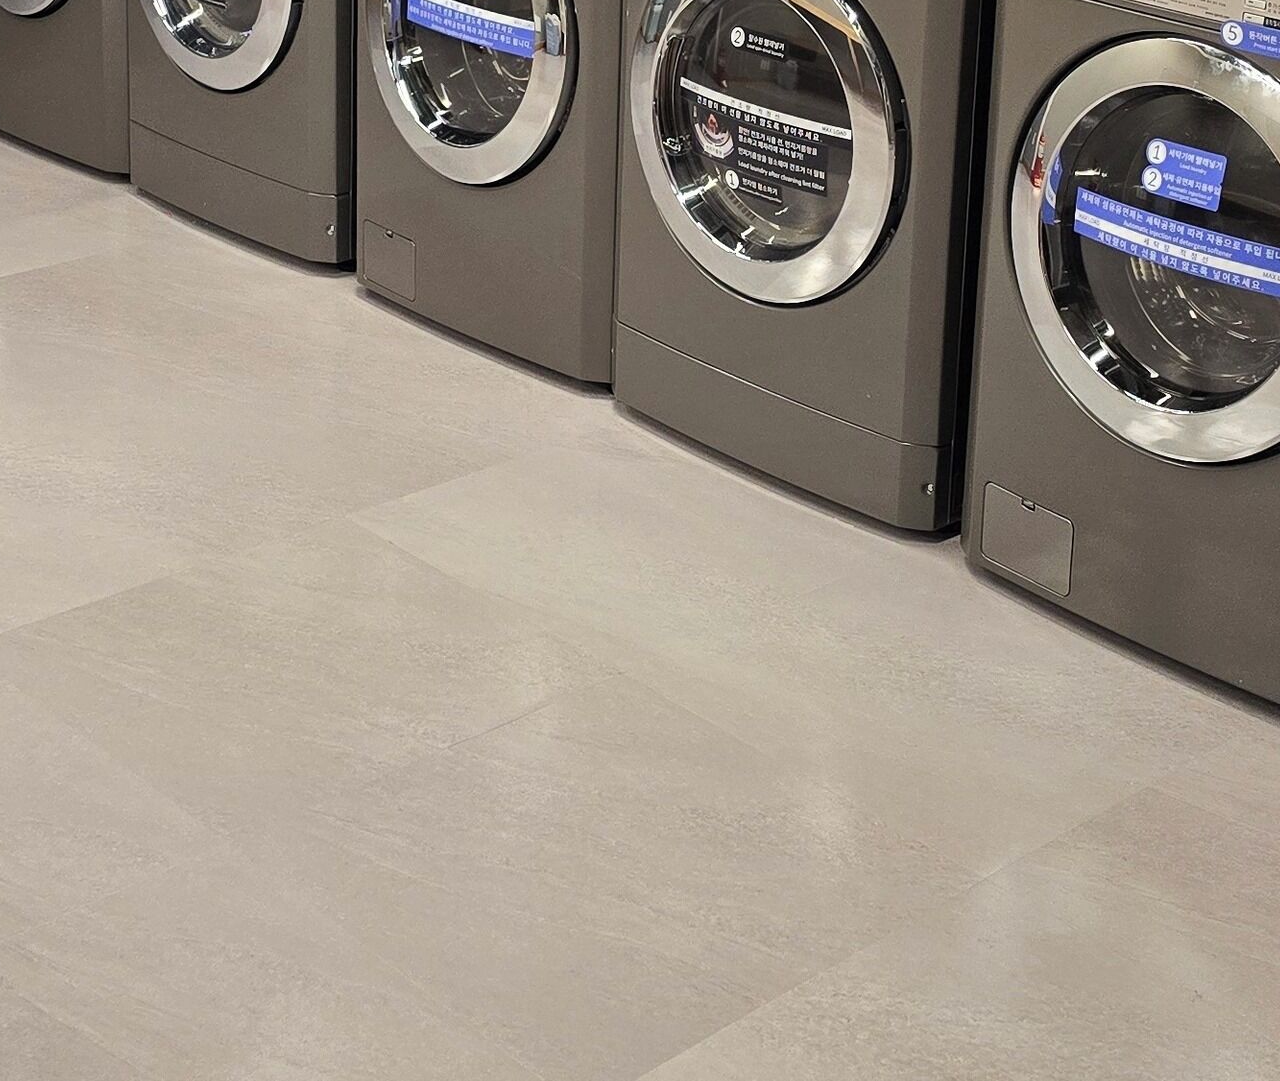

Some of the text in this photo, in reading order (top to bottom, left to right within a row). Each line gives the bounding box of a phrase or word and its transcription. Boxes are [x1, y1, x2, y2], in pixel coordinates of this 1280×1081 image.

[1249, 30, 1278, 45] 동작버튼
[1123, 220, 1148, 234] Automatic
[1146, 214, 1185, 235] 세탁공정에
[1187, 228, 1204, 241] 따라
[1206, 233, 1241, 251] 자동으로
[1244, 244, 1262, 257] 투입
[1131, 244, 1138, 254] 이
[1141, 248, 1156, 261] 선을
[1161, 254, 1177, 267] 넘지
[1182, 261, 1208, 276] 않도록
[1212, 270, 1265, 291] 넣어주세요.
[1263, 272, 1276, 280] MAX
